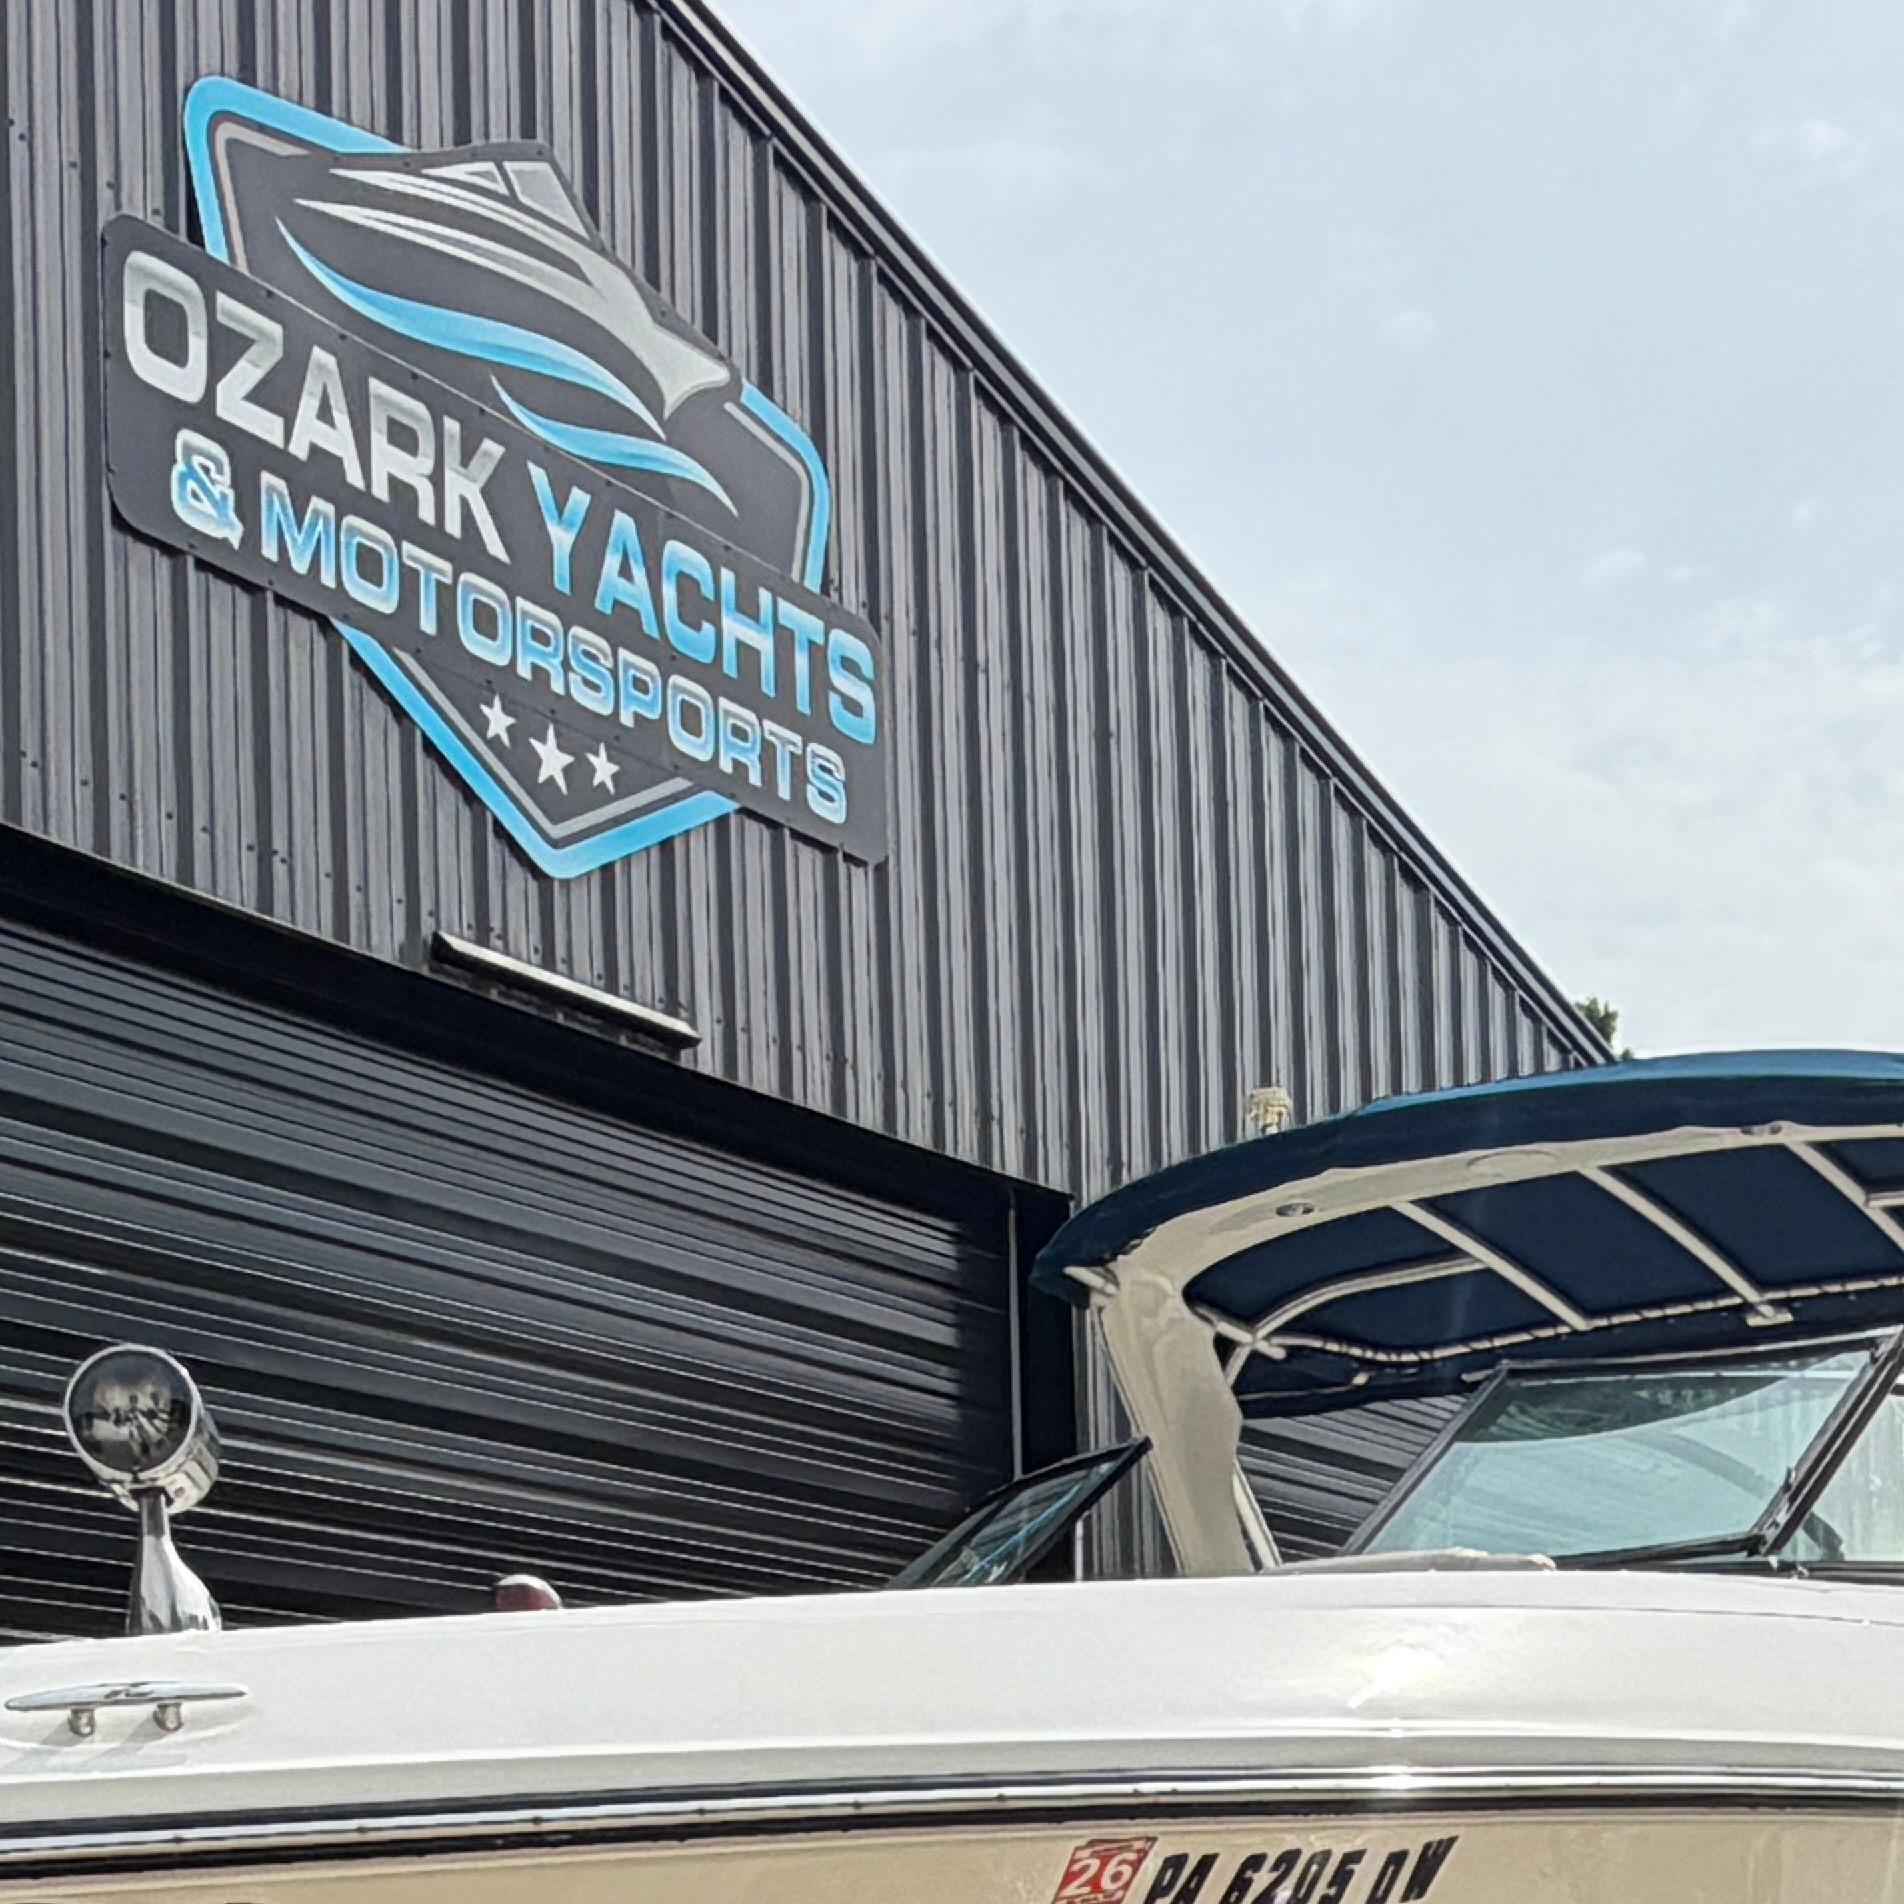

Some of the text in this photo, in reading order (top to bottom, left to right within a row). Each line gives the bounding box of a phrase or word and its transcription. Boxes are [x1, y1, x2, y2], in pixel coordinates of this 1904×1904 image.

[122, 250, 877, 746] OZARK YACHTS
[170, 428, 849, 826] & MOTORSPORTS
[1059, 1852, 1138, 1896] 26
